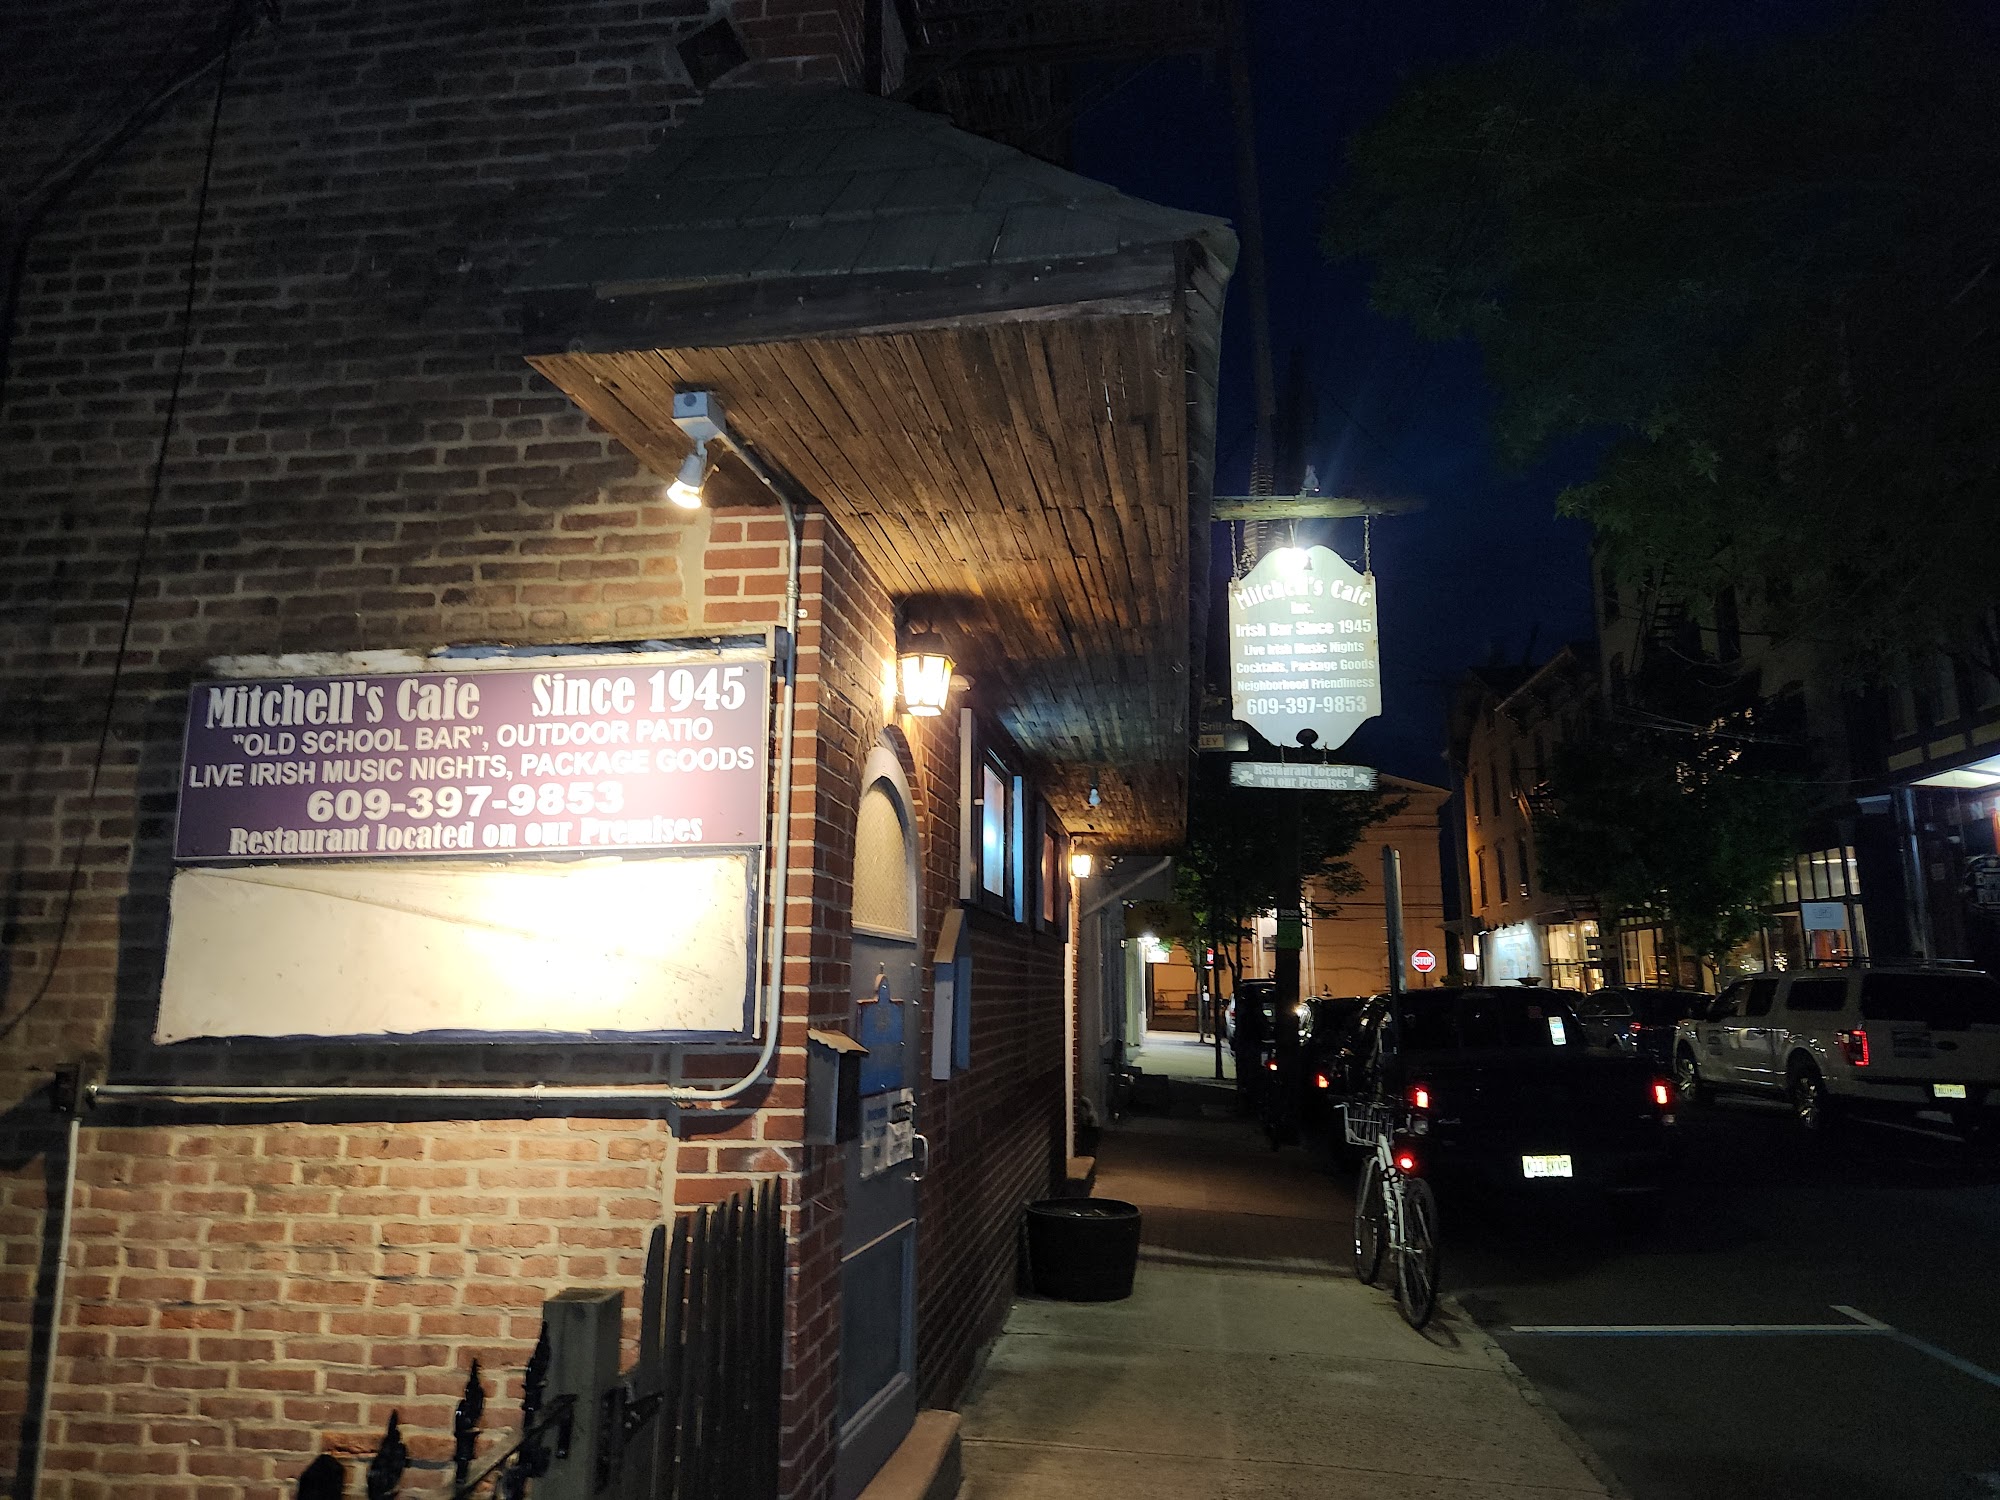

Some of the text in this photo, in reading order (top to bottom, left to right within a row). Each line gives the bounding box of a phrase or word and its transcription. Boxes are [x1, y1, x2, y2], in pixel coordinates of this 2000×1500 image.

[1234, 575, 1372, 610] Mitchell's Cafe
[1290, 601, 1314, 614] Inc.
[1236, 619, 1371, 637] Irish Bar Since 1945
[1244, 641, 1364, 655] Live Irish Music Nights
[1236, 658, 1375, 674] Cocktails, Package Goods
[1237, 677, 1375, 691] Neighborhood Friendliness
[207, 666, 747, 728] Mitchell's Cafe Since 1945
[1246, 695, 1368, 715] 609-397-9853
[233, 716, 714, 757] "OLD SCHOOL BAR", OUTDOOR PATIO
[190, 744, 754, 788] LIVE IRISH MUSIC NIGHTS, PACKAGE GOODS
[1254, 764, 1354, 777] Restaurant located
[1261, 777, 1347, 788] on our Premises
[306, 781, 625, 822] 609-397-9853
[229, 814, 703, 855] Restaurant located on our Premises
[1414, 956, 1434, 967] STOP
